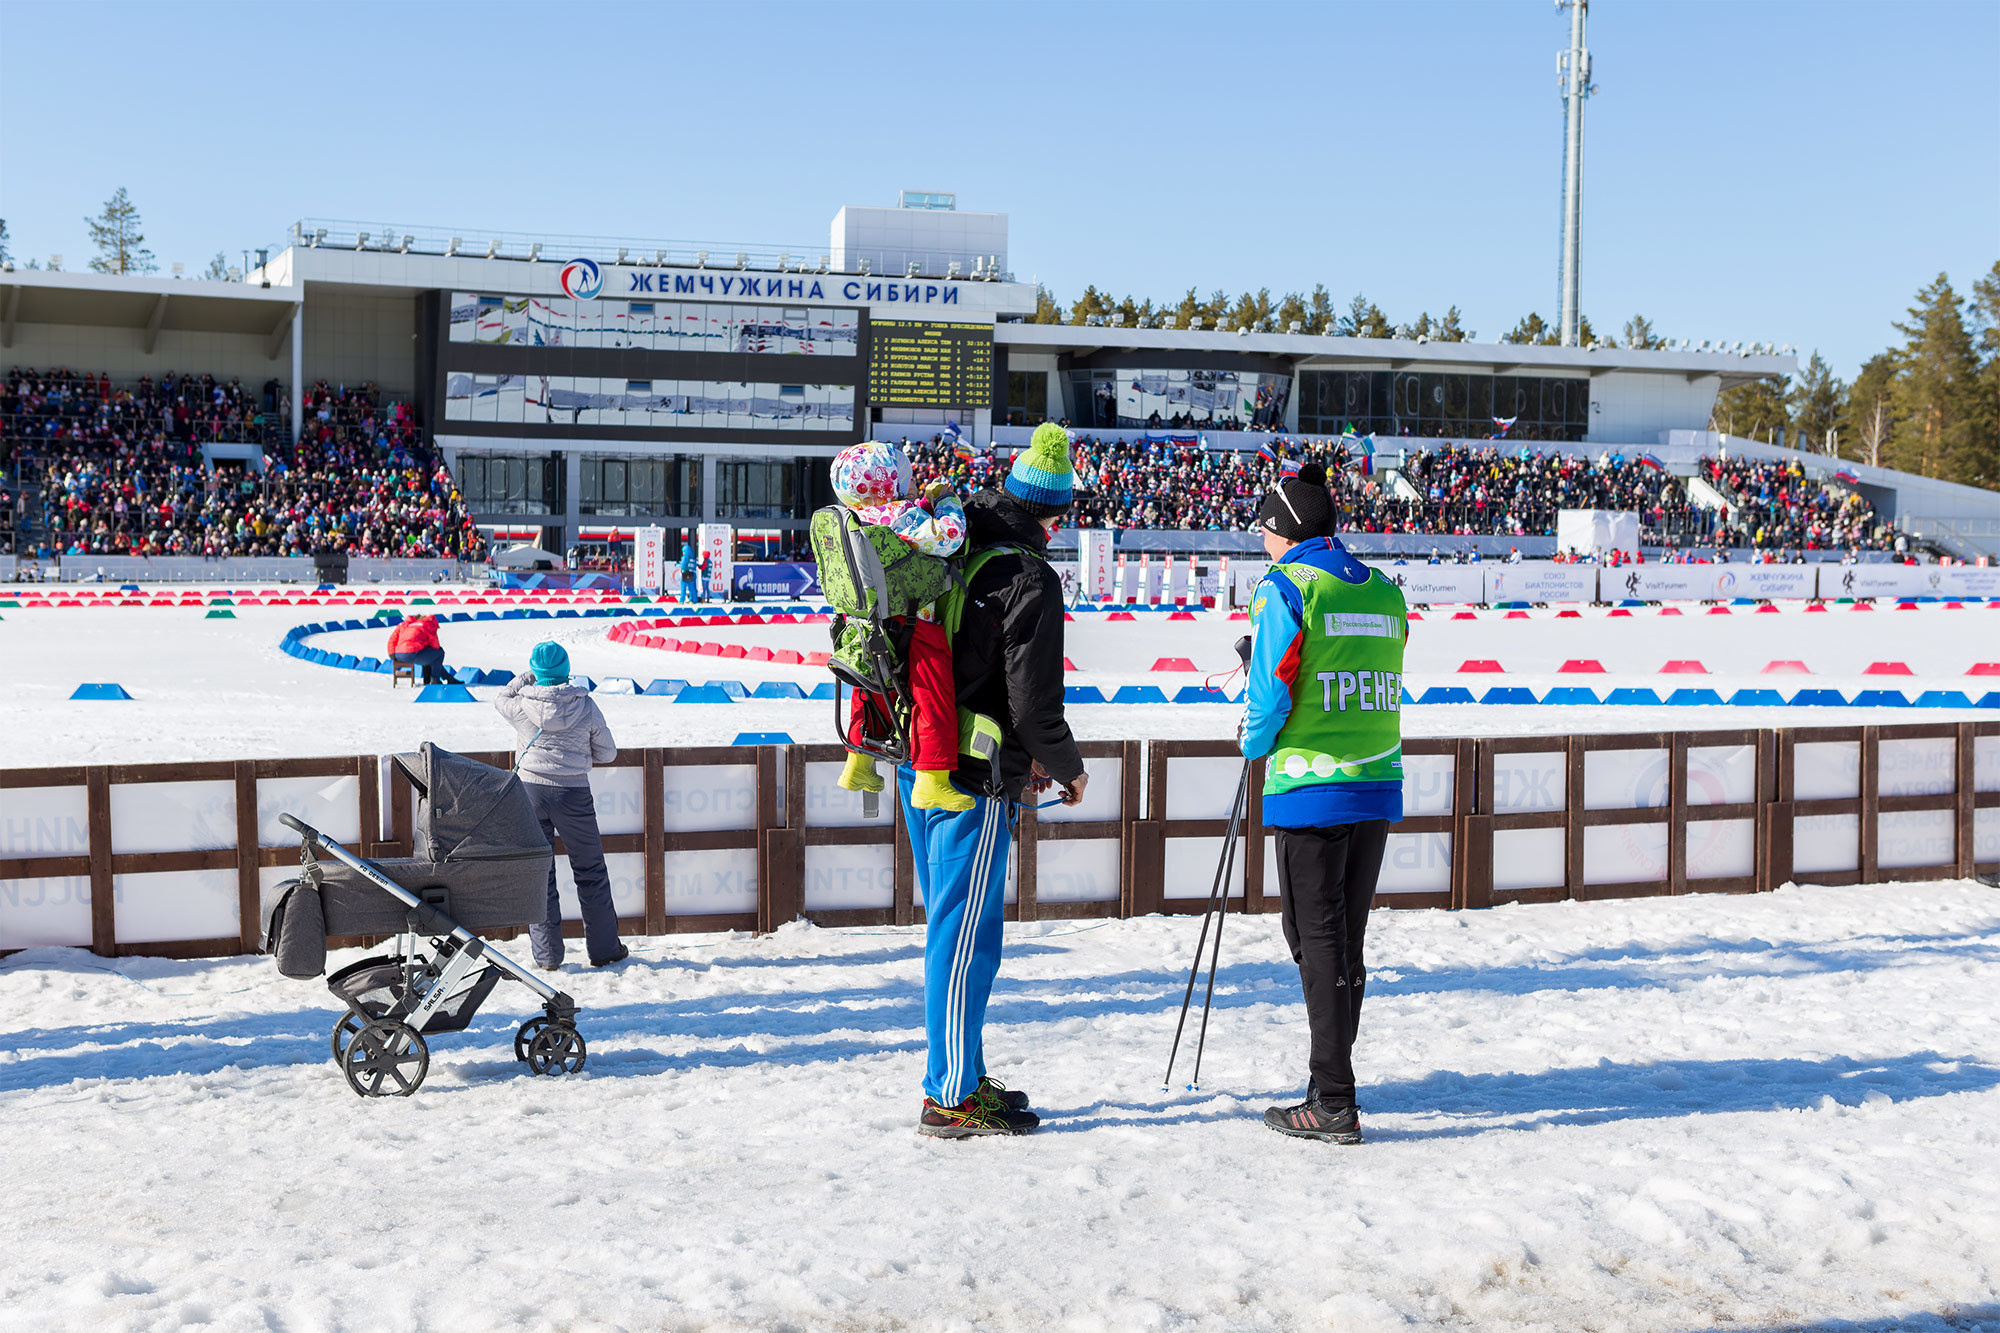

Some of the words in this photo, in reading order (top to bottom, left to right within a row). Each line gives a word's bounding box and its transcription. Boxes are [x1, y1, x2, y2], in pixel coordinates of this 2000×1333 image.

[629, 271, 825, 300] ЖЕМЧУЖИНА
[843, 281, 960, 305] СИБИРИ
[645, 541, 656, 588] ФИНИШ
[712, 538, 724, 592] ФИНИШ
[1098, 544, 1106, 596] СТАРТ
[1292, 567, 1319, 582] 159
[1543, 572, 1566, 580] СОЮЗ
[1749, 573, 1804, 583] ЖЕМЧУЖИНА
[755, 583, 790, 593] ГАЗПРОМ
[1411, 584, 1457, 593] VisitTyumen
[1525, 582, 1584, 590] БИАТЛОНИСТОВ
[1645, 582, 1687, 591] VisitTyumen
[1760, 583, 1795, 593] СИБИРИ
[1539, 591, 1570, 599] РОССИИ
[423, 988, 444, 1012] SALSA
